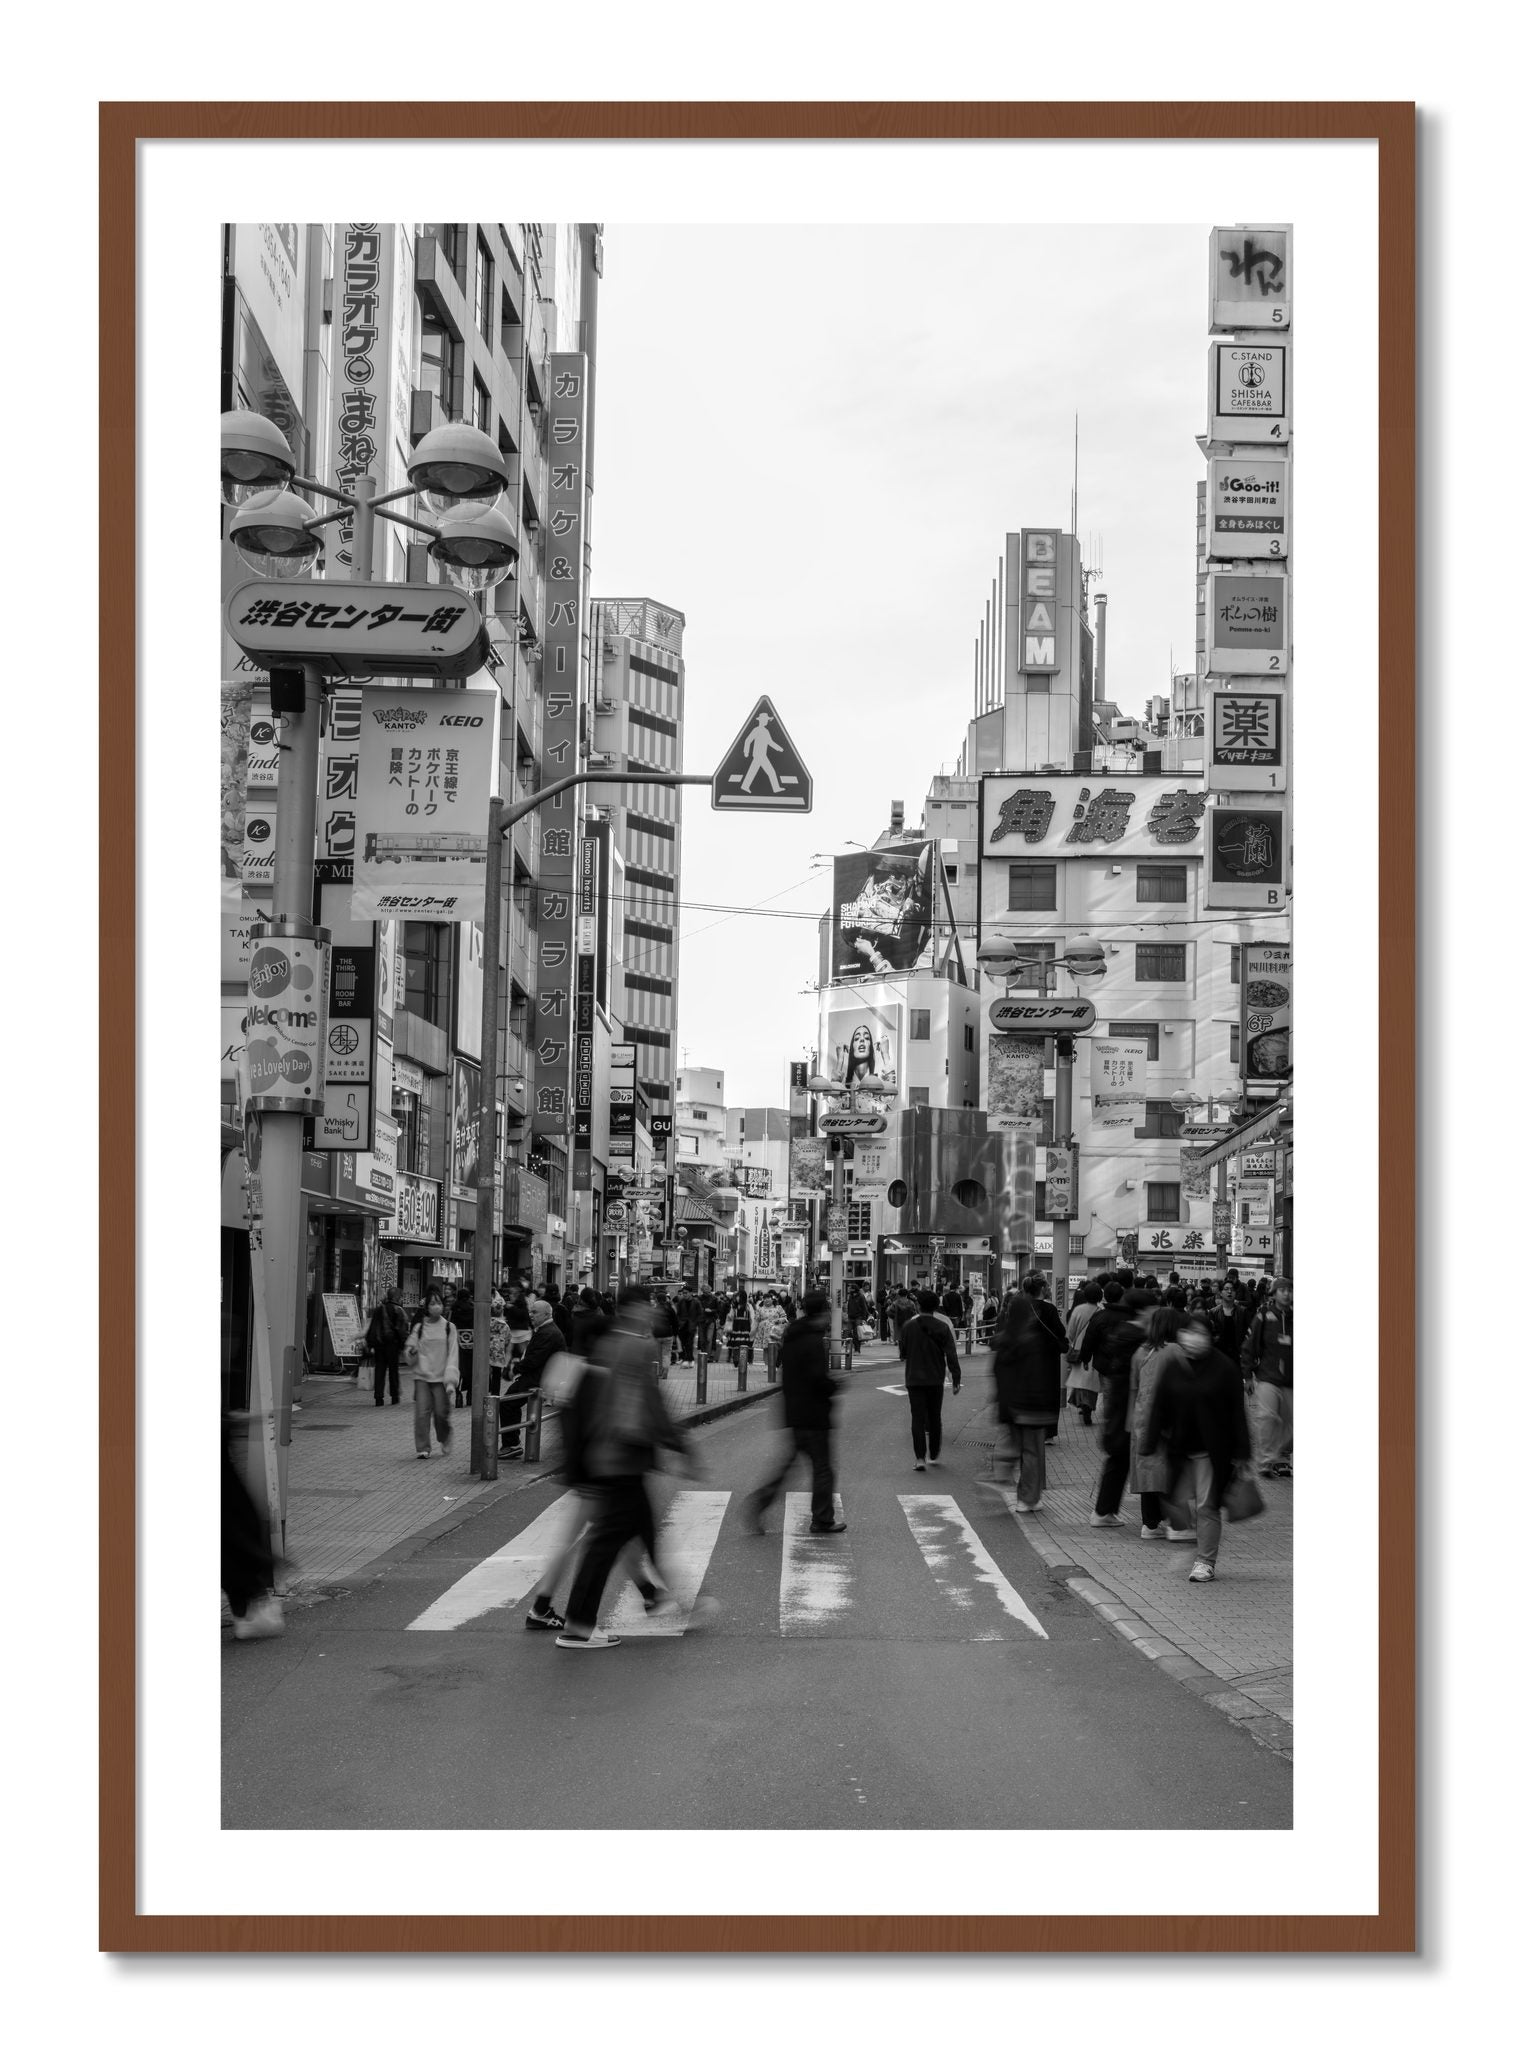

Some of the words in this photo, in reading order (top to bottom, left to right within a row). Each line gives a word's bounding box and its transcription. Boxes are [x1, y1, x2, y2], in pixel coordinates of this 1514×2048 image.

[343, 231, 381, 358] カラオケ
[1272, 309, 1283, 322] 5
[1231, 352, 1272, 361] C.STAND
[1231, 390, 1272, 398] SHISHA
[1270, 424, 1282, 438] 4
[1230, 478, 1280, 493] Goo-it!
[1219, 520, 1281, 530] 全身もみほぐし
[1269, 540, 1280, 554] 3
[1026, 533, 1056, 665] BEAM
[239, 600, 467, 634] 渋谷センター街
[1269, 656, 1280, 670] 2
[439, 715, 484, 728] KEIO
[1223, 700, 1268, 747] 薬
[251, 773, 274, 781] 渋谷店
[405, 747, 422, 816] カントーの
[424, 747, 441, 816] ポケパーク
[443, 748, 460, 803] 京王線で
[1269, 773, 1277, 787] 1
[989, 788, 1206, 844] 角海老
[1218, 824, 1272, 868] 一蘭
[584, 842, 593, 875] kimono
[247, 871, 271, 879] 渋谷店
[377, 896, 458, 908] 渋谷センター街
[583, 879, 592, 911] hearts
[1268, 890, 1278, 904] B
[250, 959, 289, 991] Enjoy
[248, 1004, 317, 1028] Welcome
[996, 1006, 1090, 1018] 渋谷センター街
[1247, 1014, 1273, 1033] 6F
[263, 1058, 291, 1075] Lovely
[292, 1059, 310, 1072] Day!
[324, 1118, 354, 1128] Whisky
[652, 1121, 671, 1131] GU
[760, 1229, 769, 1267] BEER
